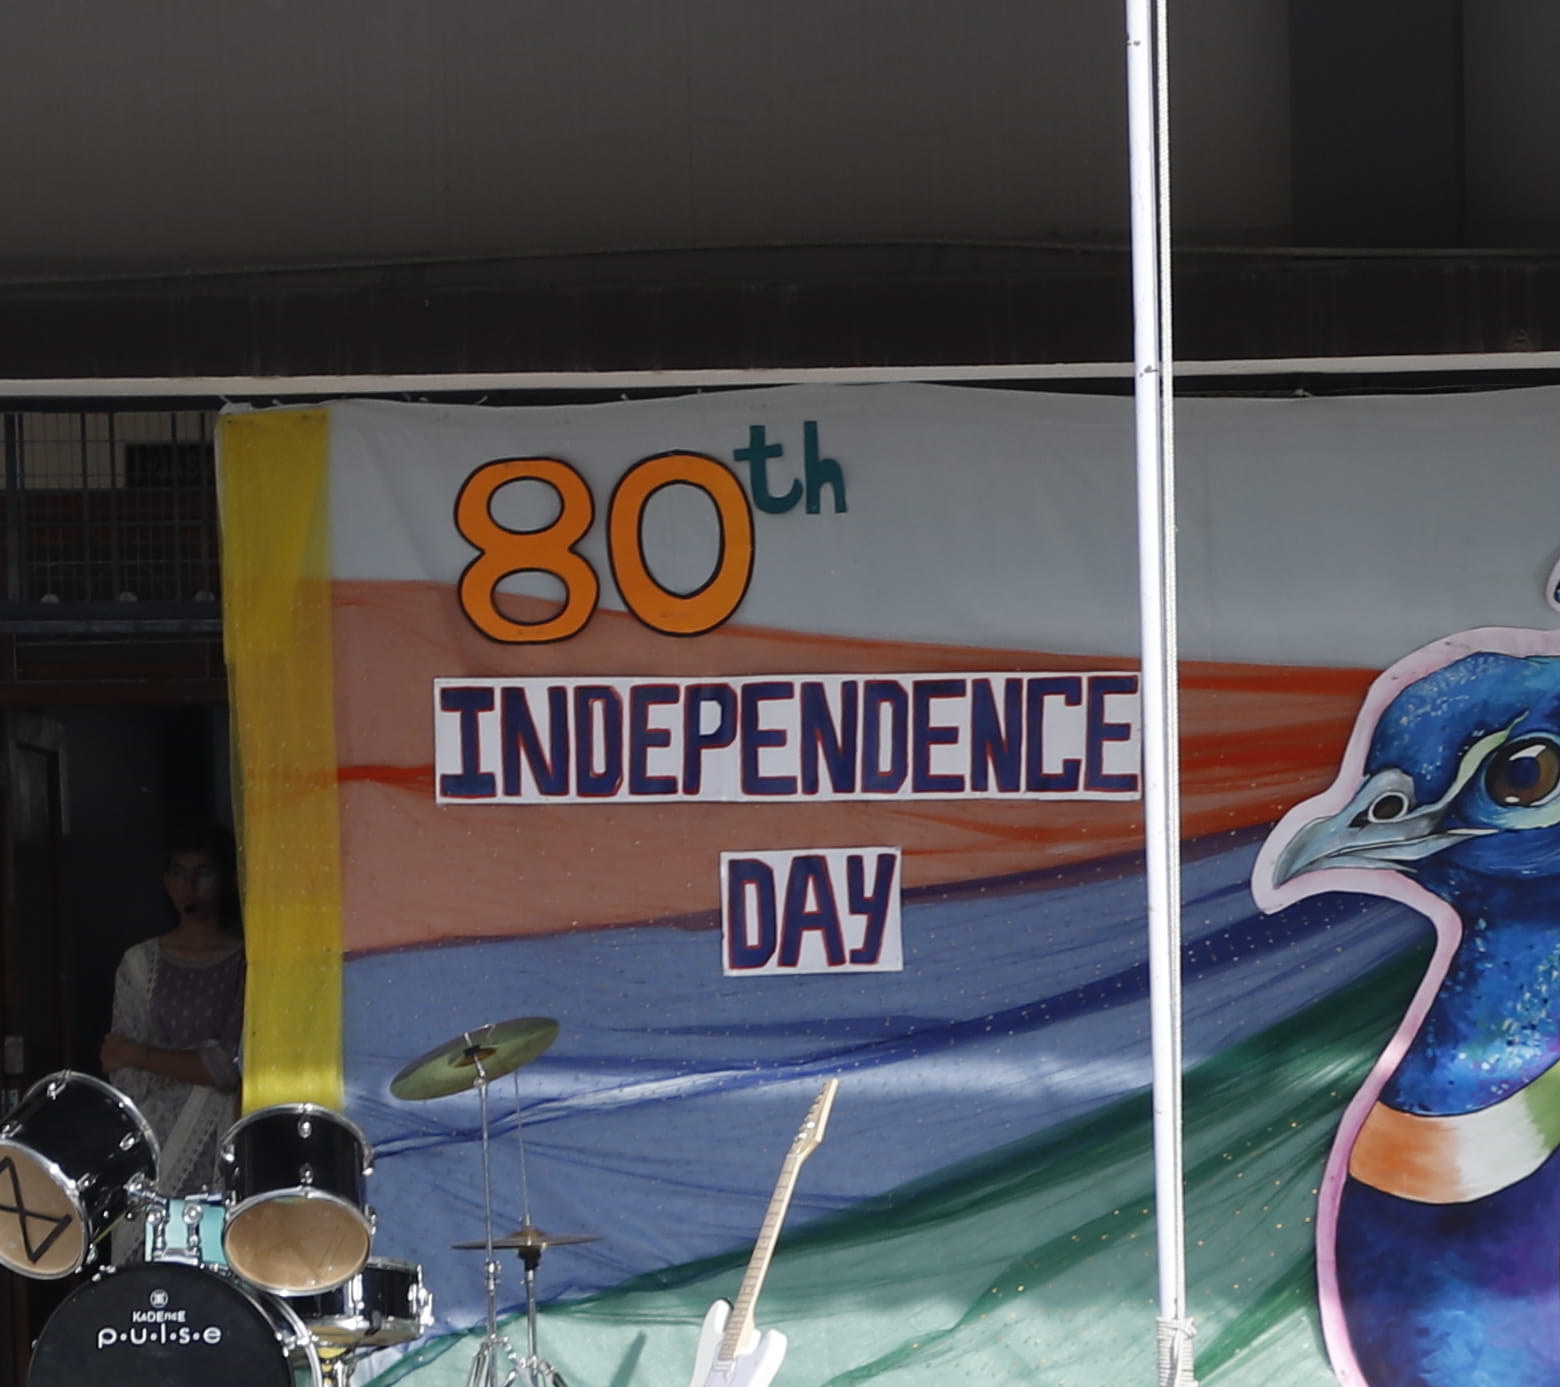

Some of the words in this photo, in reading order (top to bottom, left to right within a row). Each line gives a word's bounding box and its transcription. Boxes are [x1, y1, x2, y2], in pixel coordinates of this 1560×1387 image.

[453, 420, 847, 644] 80th
[439, 676, 1139, 797] INDEPENDENCE
[727, 853, 896, 968] DAY
